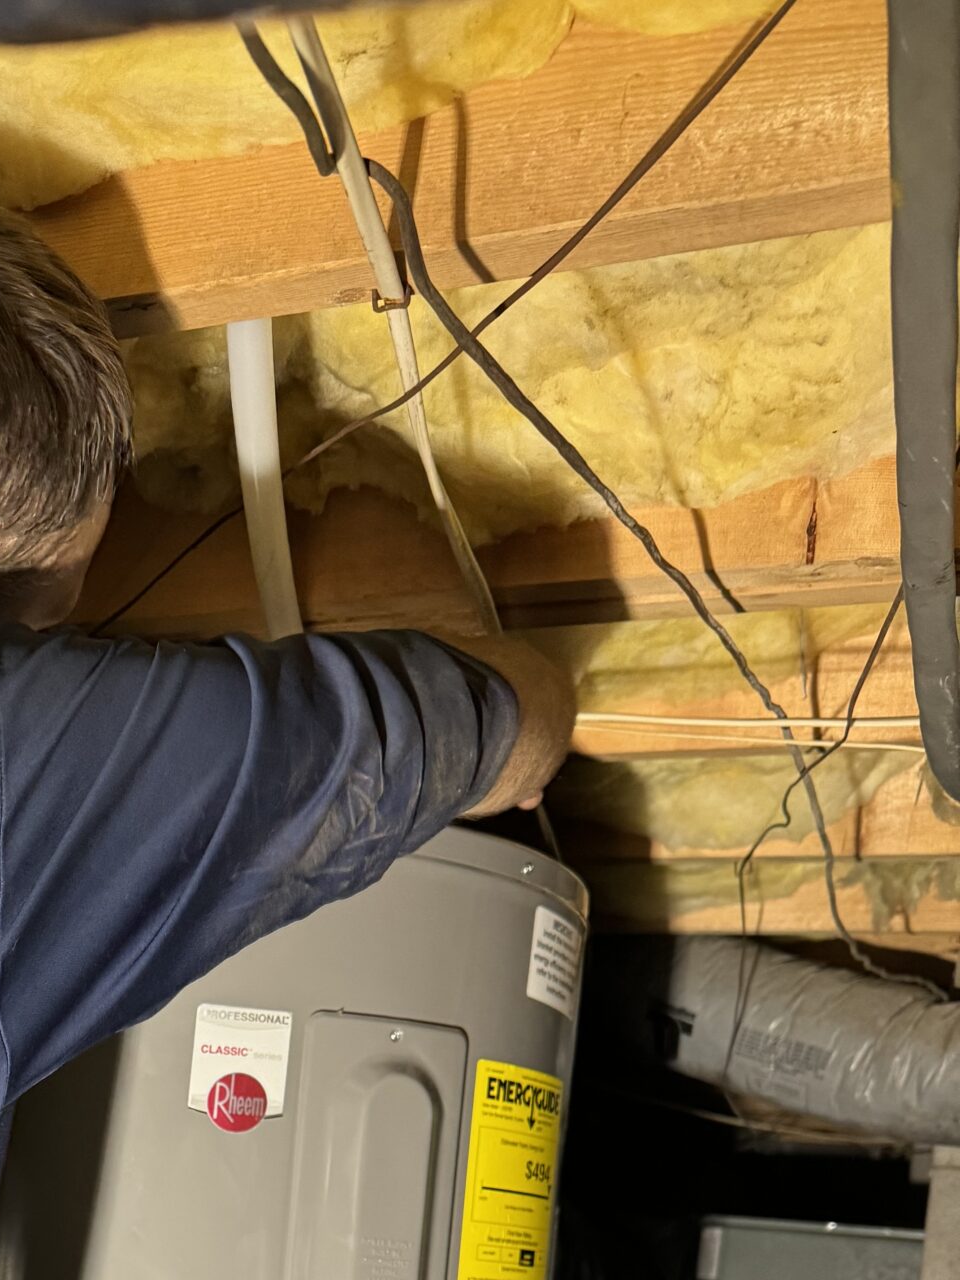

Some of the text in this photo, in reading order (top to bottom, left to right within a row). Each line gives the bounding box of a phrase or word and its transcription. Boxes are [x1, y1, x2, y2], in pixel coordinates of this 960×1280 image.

[200, 1044, 249, 1057] CLASSIC
[212, 1073, 264, 1124] Rheem
[525, 1160, 551, 1183] $494
